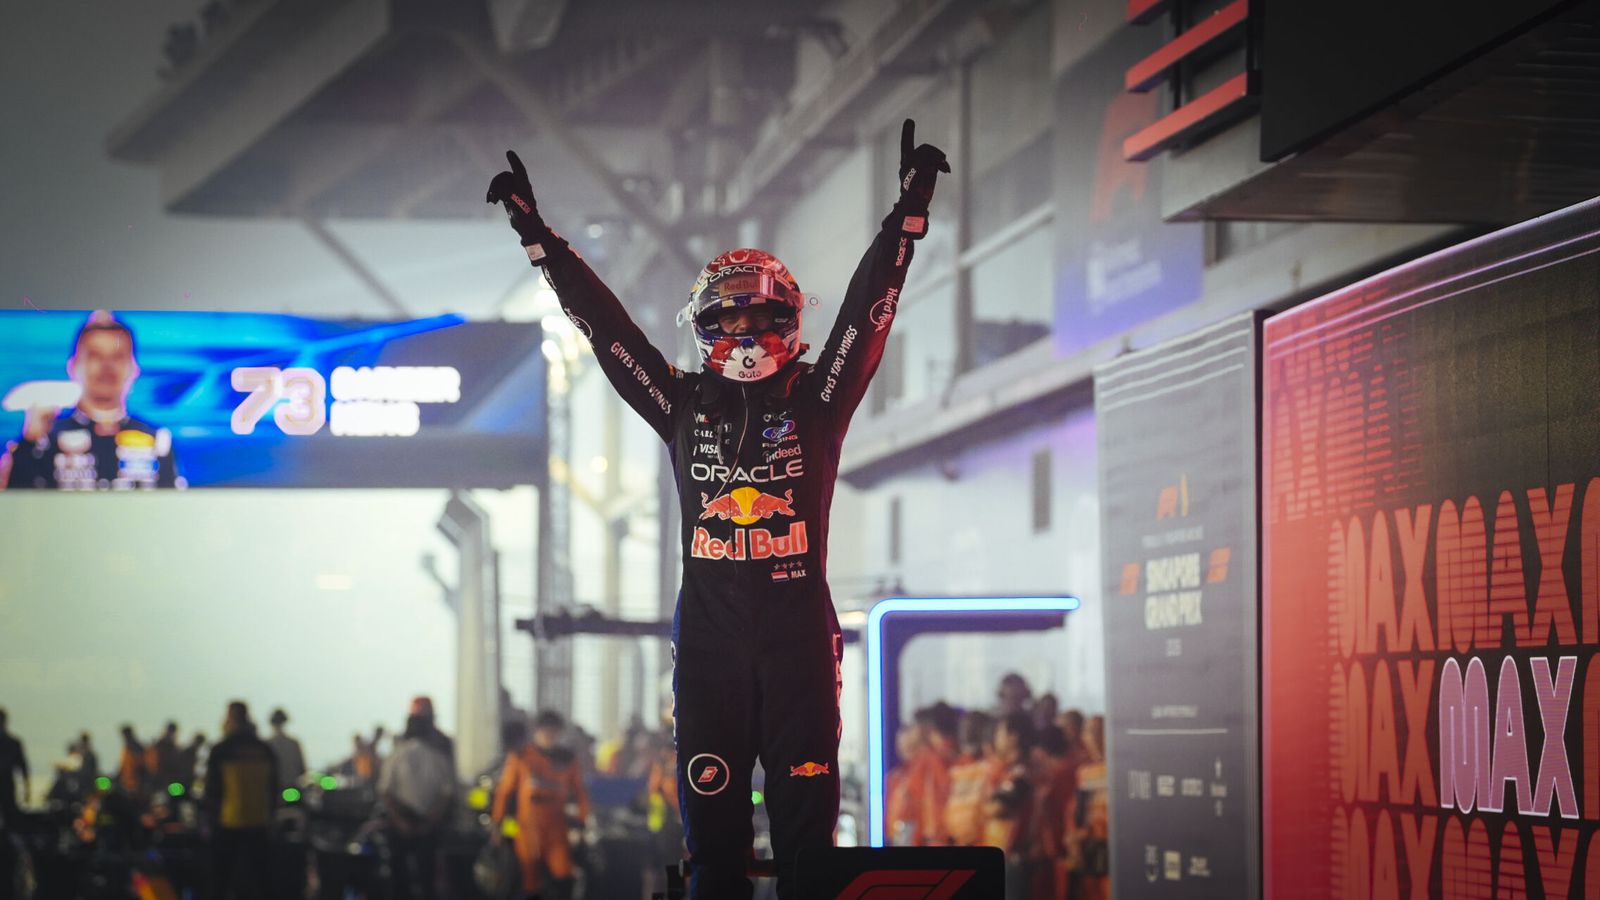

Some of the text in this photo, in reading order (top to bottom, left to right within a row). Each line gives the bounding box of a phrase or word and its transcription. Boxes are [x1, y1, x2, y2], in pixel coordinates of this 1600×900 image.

[611, 341, 635, 368] GIVES
[633, 364, 651, 386] YOU
[691, 459, 804, 483] ORACLE
[766, 444, 802, 463] indeed
[691, 521, 808, 561] Red Bull
[791, 569, 807, 579] MAX
[1436, 483, 1577, 654] MAX
[1439, 655, 1579, 820] MAX
